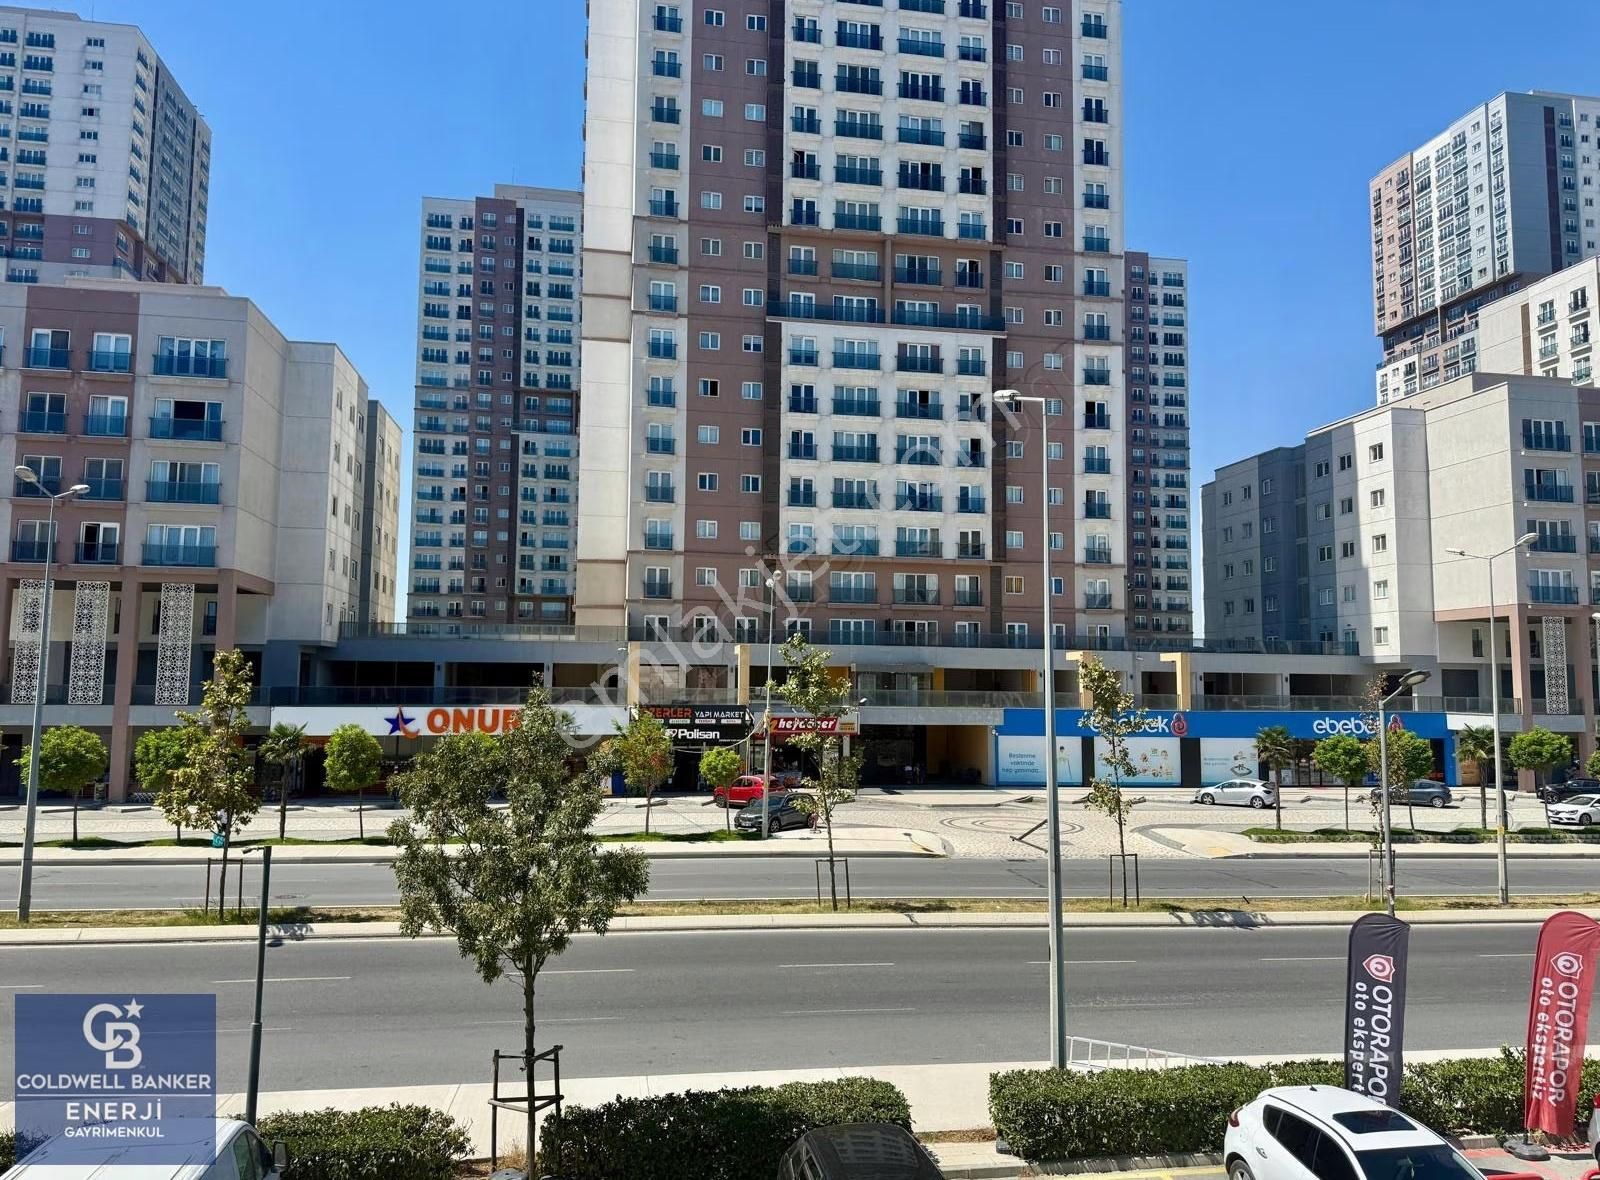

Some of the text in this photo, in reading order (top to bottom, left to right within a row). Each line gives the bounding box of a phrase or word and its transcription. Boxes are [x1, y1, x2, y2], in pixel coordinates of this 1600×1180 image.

[678, 728, 720, 739] Polisan
[714, 711, 744, 719] MARKET
[1313, 716, 1382, 734] ebebe
[1350, 981, 1370, 1092] oto ekspert
[1532, 977, 1555, 1101] oto ekspertiz
[1548, 981, 1579, 1107] OTORAPOR
